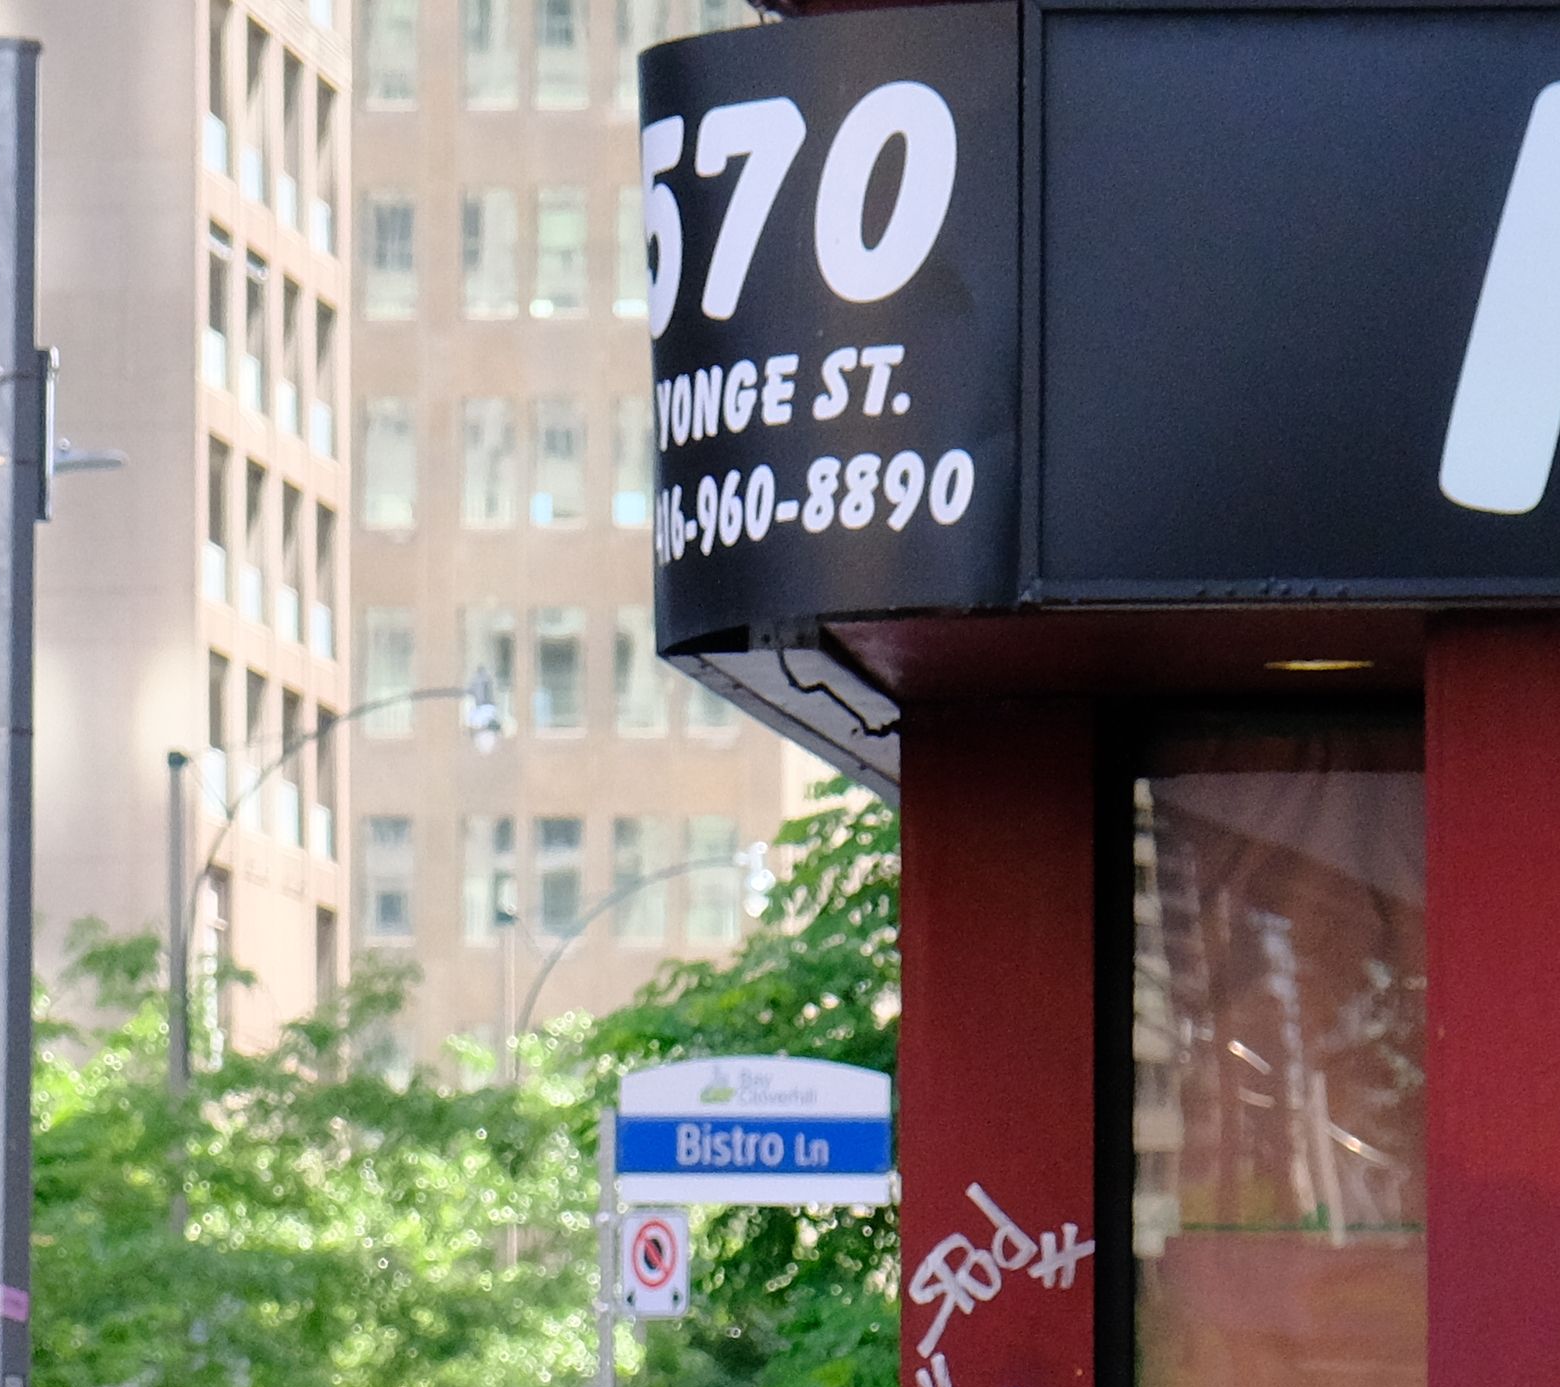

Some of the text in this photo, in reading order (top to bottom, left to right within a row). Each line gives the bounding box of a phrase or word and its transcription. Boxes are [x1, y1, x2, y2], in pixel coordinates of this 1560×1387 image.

[640, 80, 957, 340] 570
[657, 345, 911, 450] YONGE ST.
[676, 1122, 830, 1167] Bistro Ln
